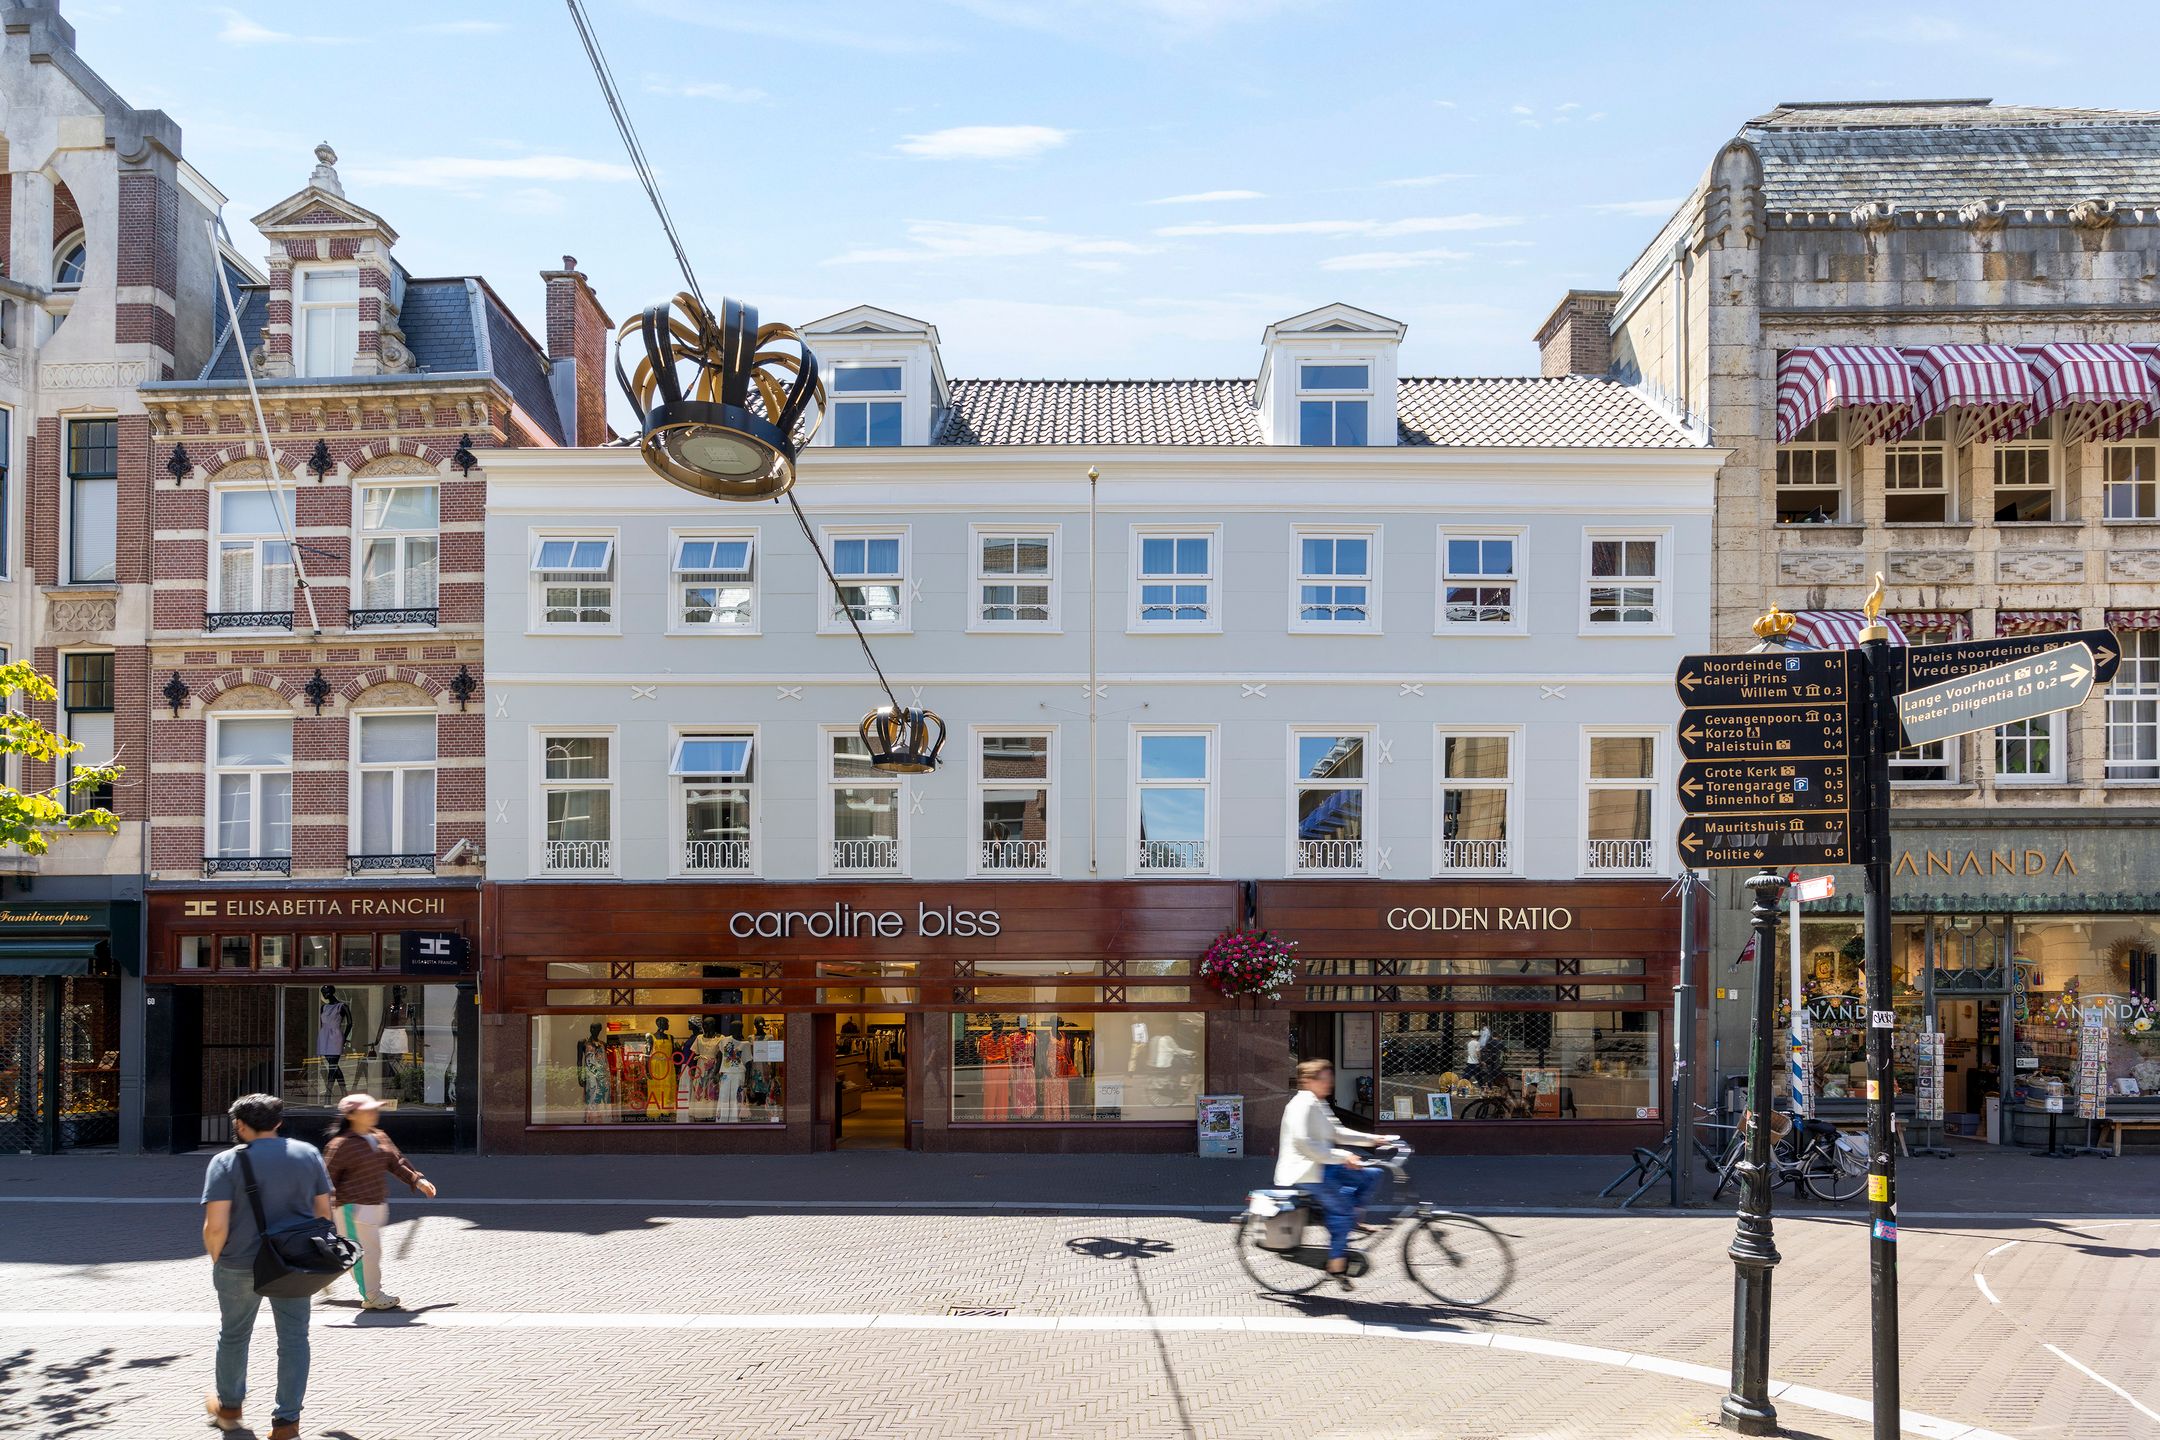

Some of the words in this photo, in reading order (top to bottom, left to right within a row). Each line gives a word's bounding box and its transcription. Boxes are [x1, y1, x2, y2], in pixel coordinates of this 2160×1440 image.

[1912, 652, 1952, 664] Paleis
[1957, 644, 2040, 661] Noordeinde
[1703, 660, 1782, 672] Noordeinde
[1824, 659, 1842, 669] 0,1
[1704, 674, 1749, 687] Galerij
[1753, 673, 1787, 684] Prins
[1904, 694, 1942, 712] Lange
[1946, 673, 2011, 700] Voorhout
[2034, 660, 2058, 676] 0,2
[1740, 687, 1787, 698] Willem
[1823, 686, 1842, 697] 0,3
[1904, 707, 1949, 726] Theater
[1951, 689, 2014, 714] Diligentia
[2036, 677, 2058, 691] 0,2
[1823, 713, 1842, 724] 0,3
[1705, 728, 1743, 739] Korzo
[1823, 727, 1843, 737] 0,4
[1706, 741, 1773, 752] Paleistuin
[1823, 740, 1843, 751] 0,4
[1704, 767, 1743, 778] Grote
[1747, 767, 1777, 777] Kerk
[1824, 766, 1843, 777] 0,5
[1706, 781, 1791, 794] Torengarage
[1824, 780, 1844, 791] 0,5
[1706, 794, 1776, 805] Binnenhof
[1824, 793, 1844, 804] 0,5
[1705, 821, 1787, 833] Mauritshuis
[1825, 820, 1844, 831] 0,7
[1706, 850, 1751, 860] Politie
[1824, 848, 1844, 858] 0,8
[1895, 849, 2079, 876] ANANDA
[226, 899, 343, 916] ELISABETTA
[351, 898, 446, 915] FRANCHI
[0, 910, 93, 926] Familiewapens
[729, 901, 904, 938] caroline
[919, 901, 1001, 937] biss
[1386, 907, 1488, 930] GOLDEN
[1498, 907, 1572, 930] RATIO
[1807, 1004, 1868, 1020] NAND
[2055, 1004, 2149, 1019] ANNDA
[628, 1090, 690, 1110] SALE
